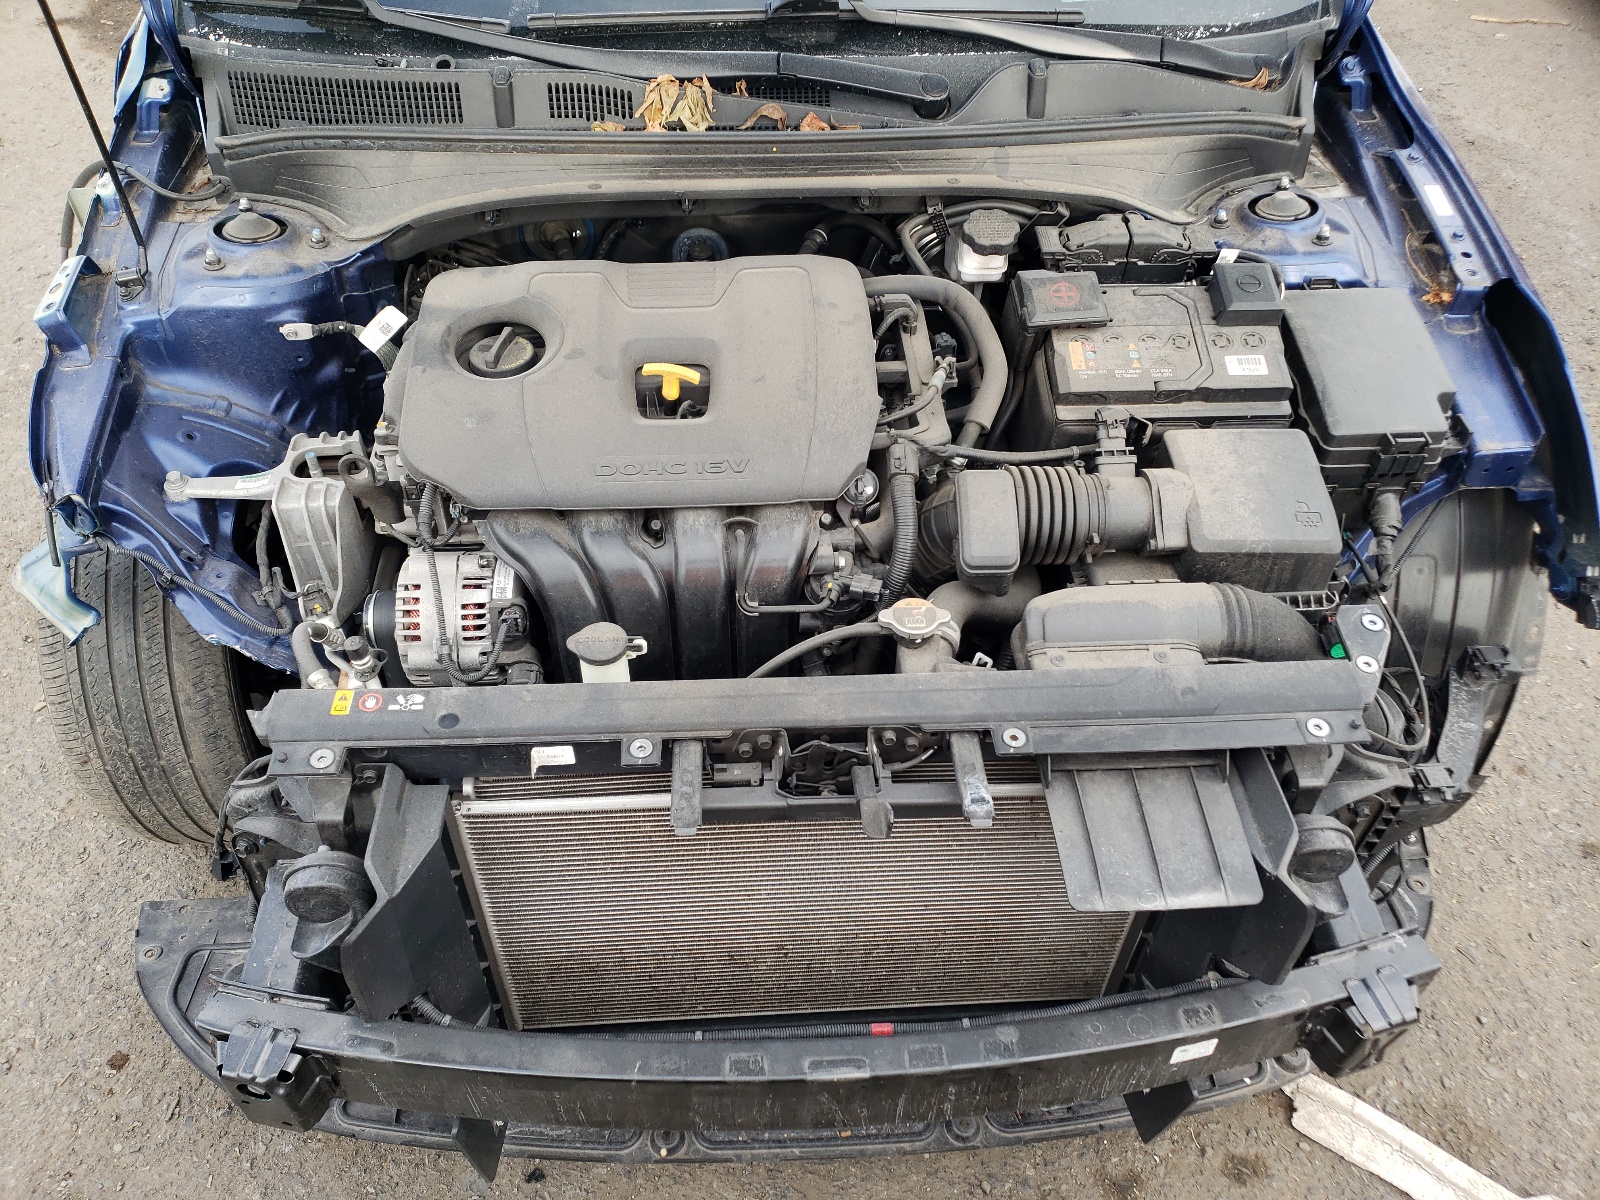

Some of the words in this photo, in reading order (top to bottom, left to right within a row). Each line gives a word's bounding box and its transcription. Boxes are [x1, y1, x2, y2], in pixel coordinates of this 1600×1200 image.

[594, 461, 688, 477] DOHC
[694, 458, 750, 475] 16V
[578, 636, 625, 644] COOLANT
